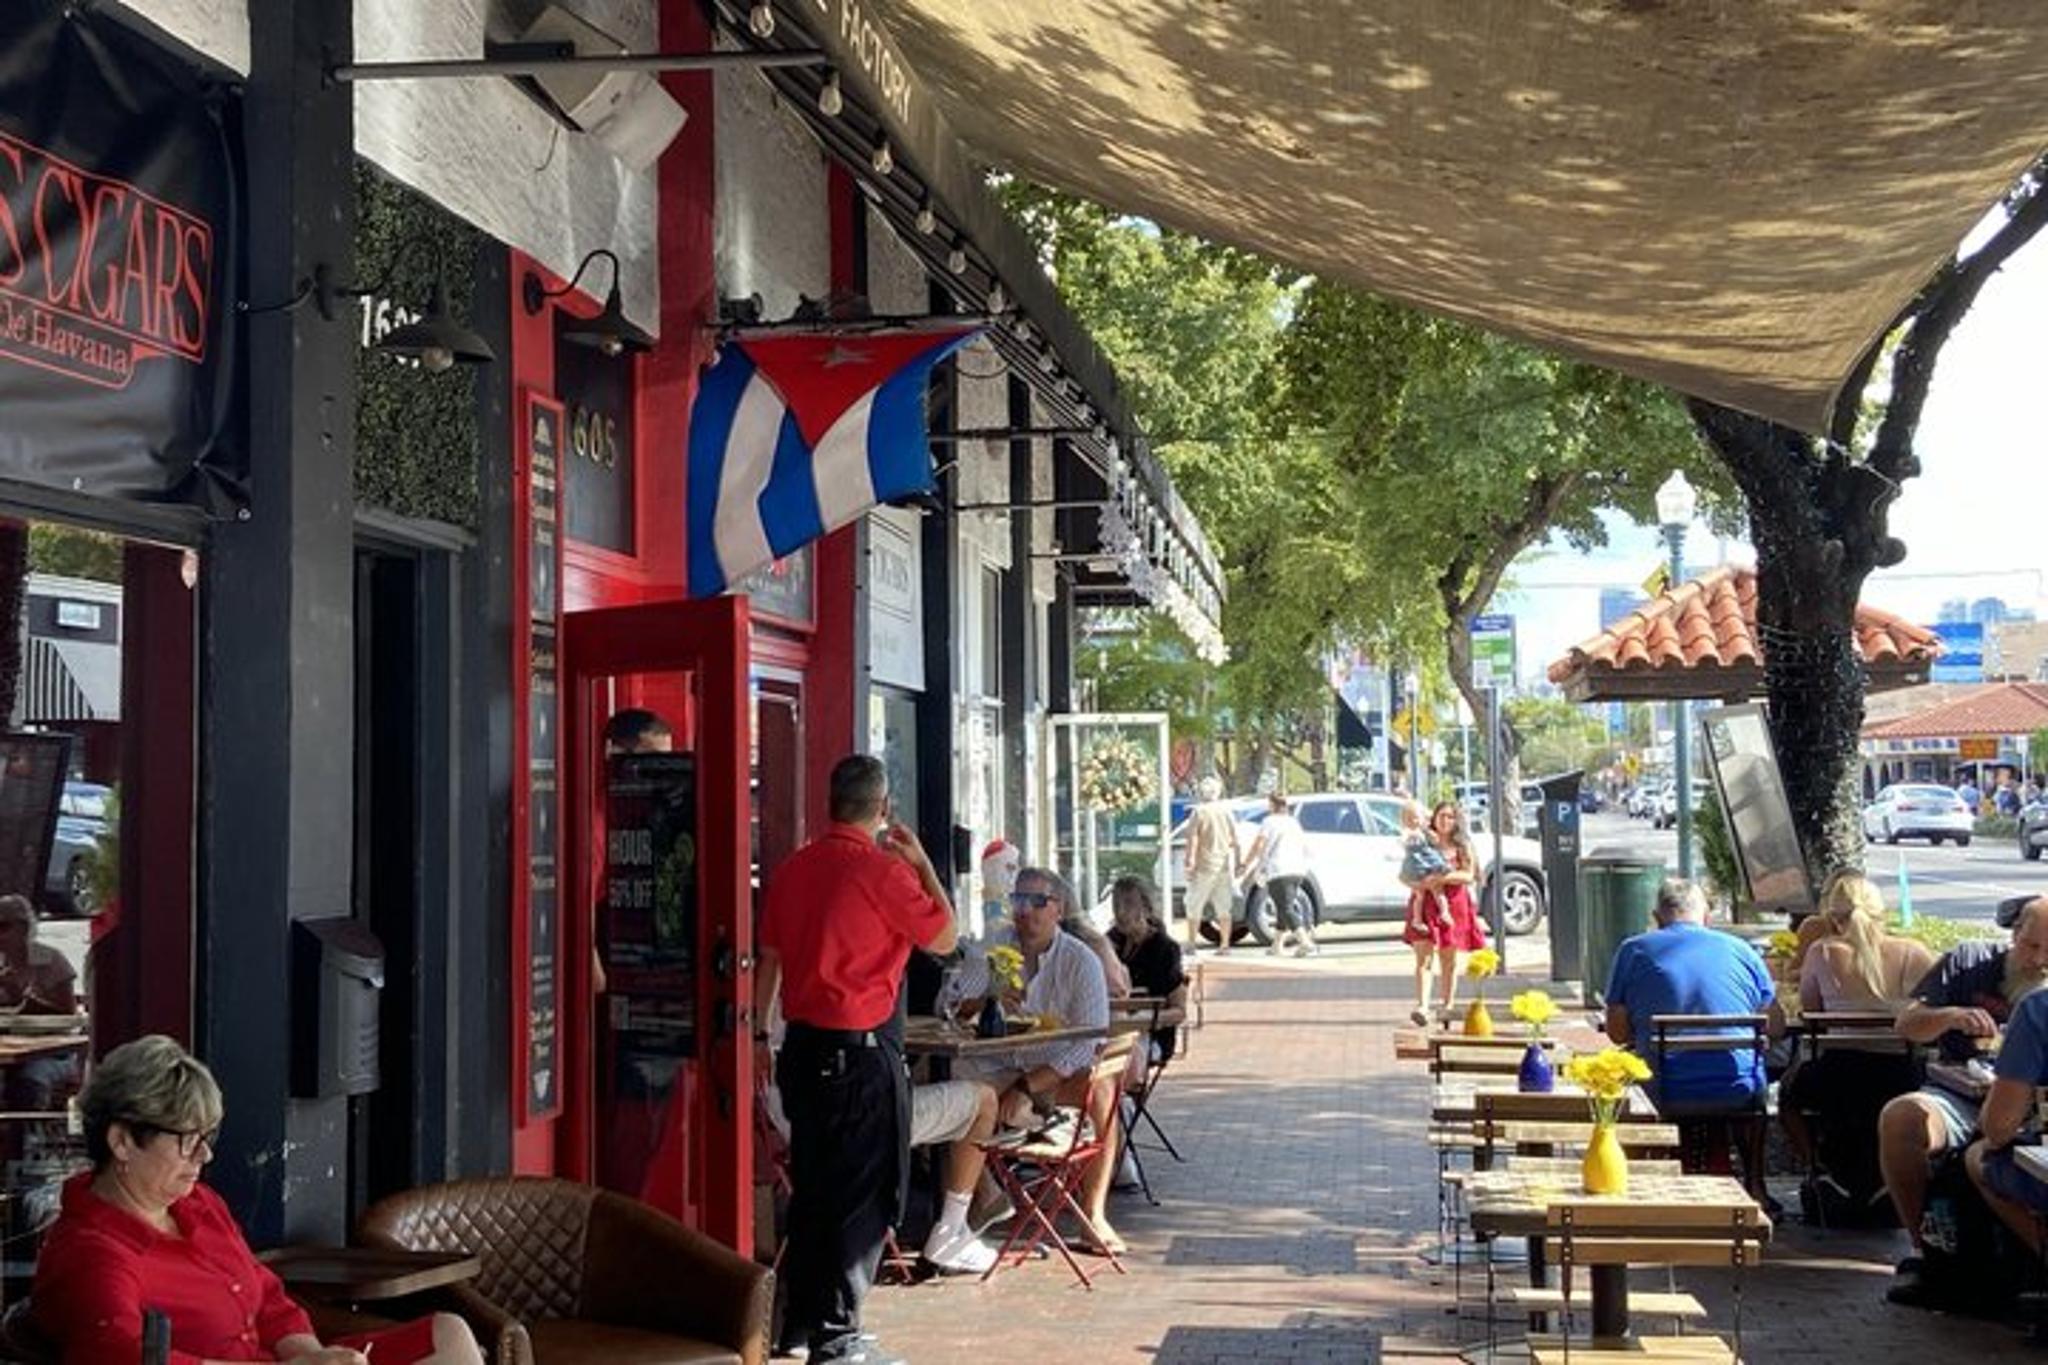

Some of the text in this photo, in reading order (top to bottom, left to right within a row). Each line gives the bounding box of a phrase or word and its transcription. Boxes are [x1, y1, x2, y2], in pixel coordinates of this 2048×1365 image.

[841, 0, 911, 124] FACTORY
[34, 166, 208, 351] CIGARS
[31, 309, 128, 374] Havana
[574, 407, 615, 470] 605
[1557, 801, 1572, 823] P
[608, 829, 651, 865] HOUR
